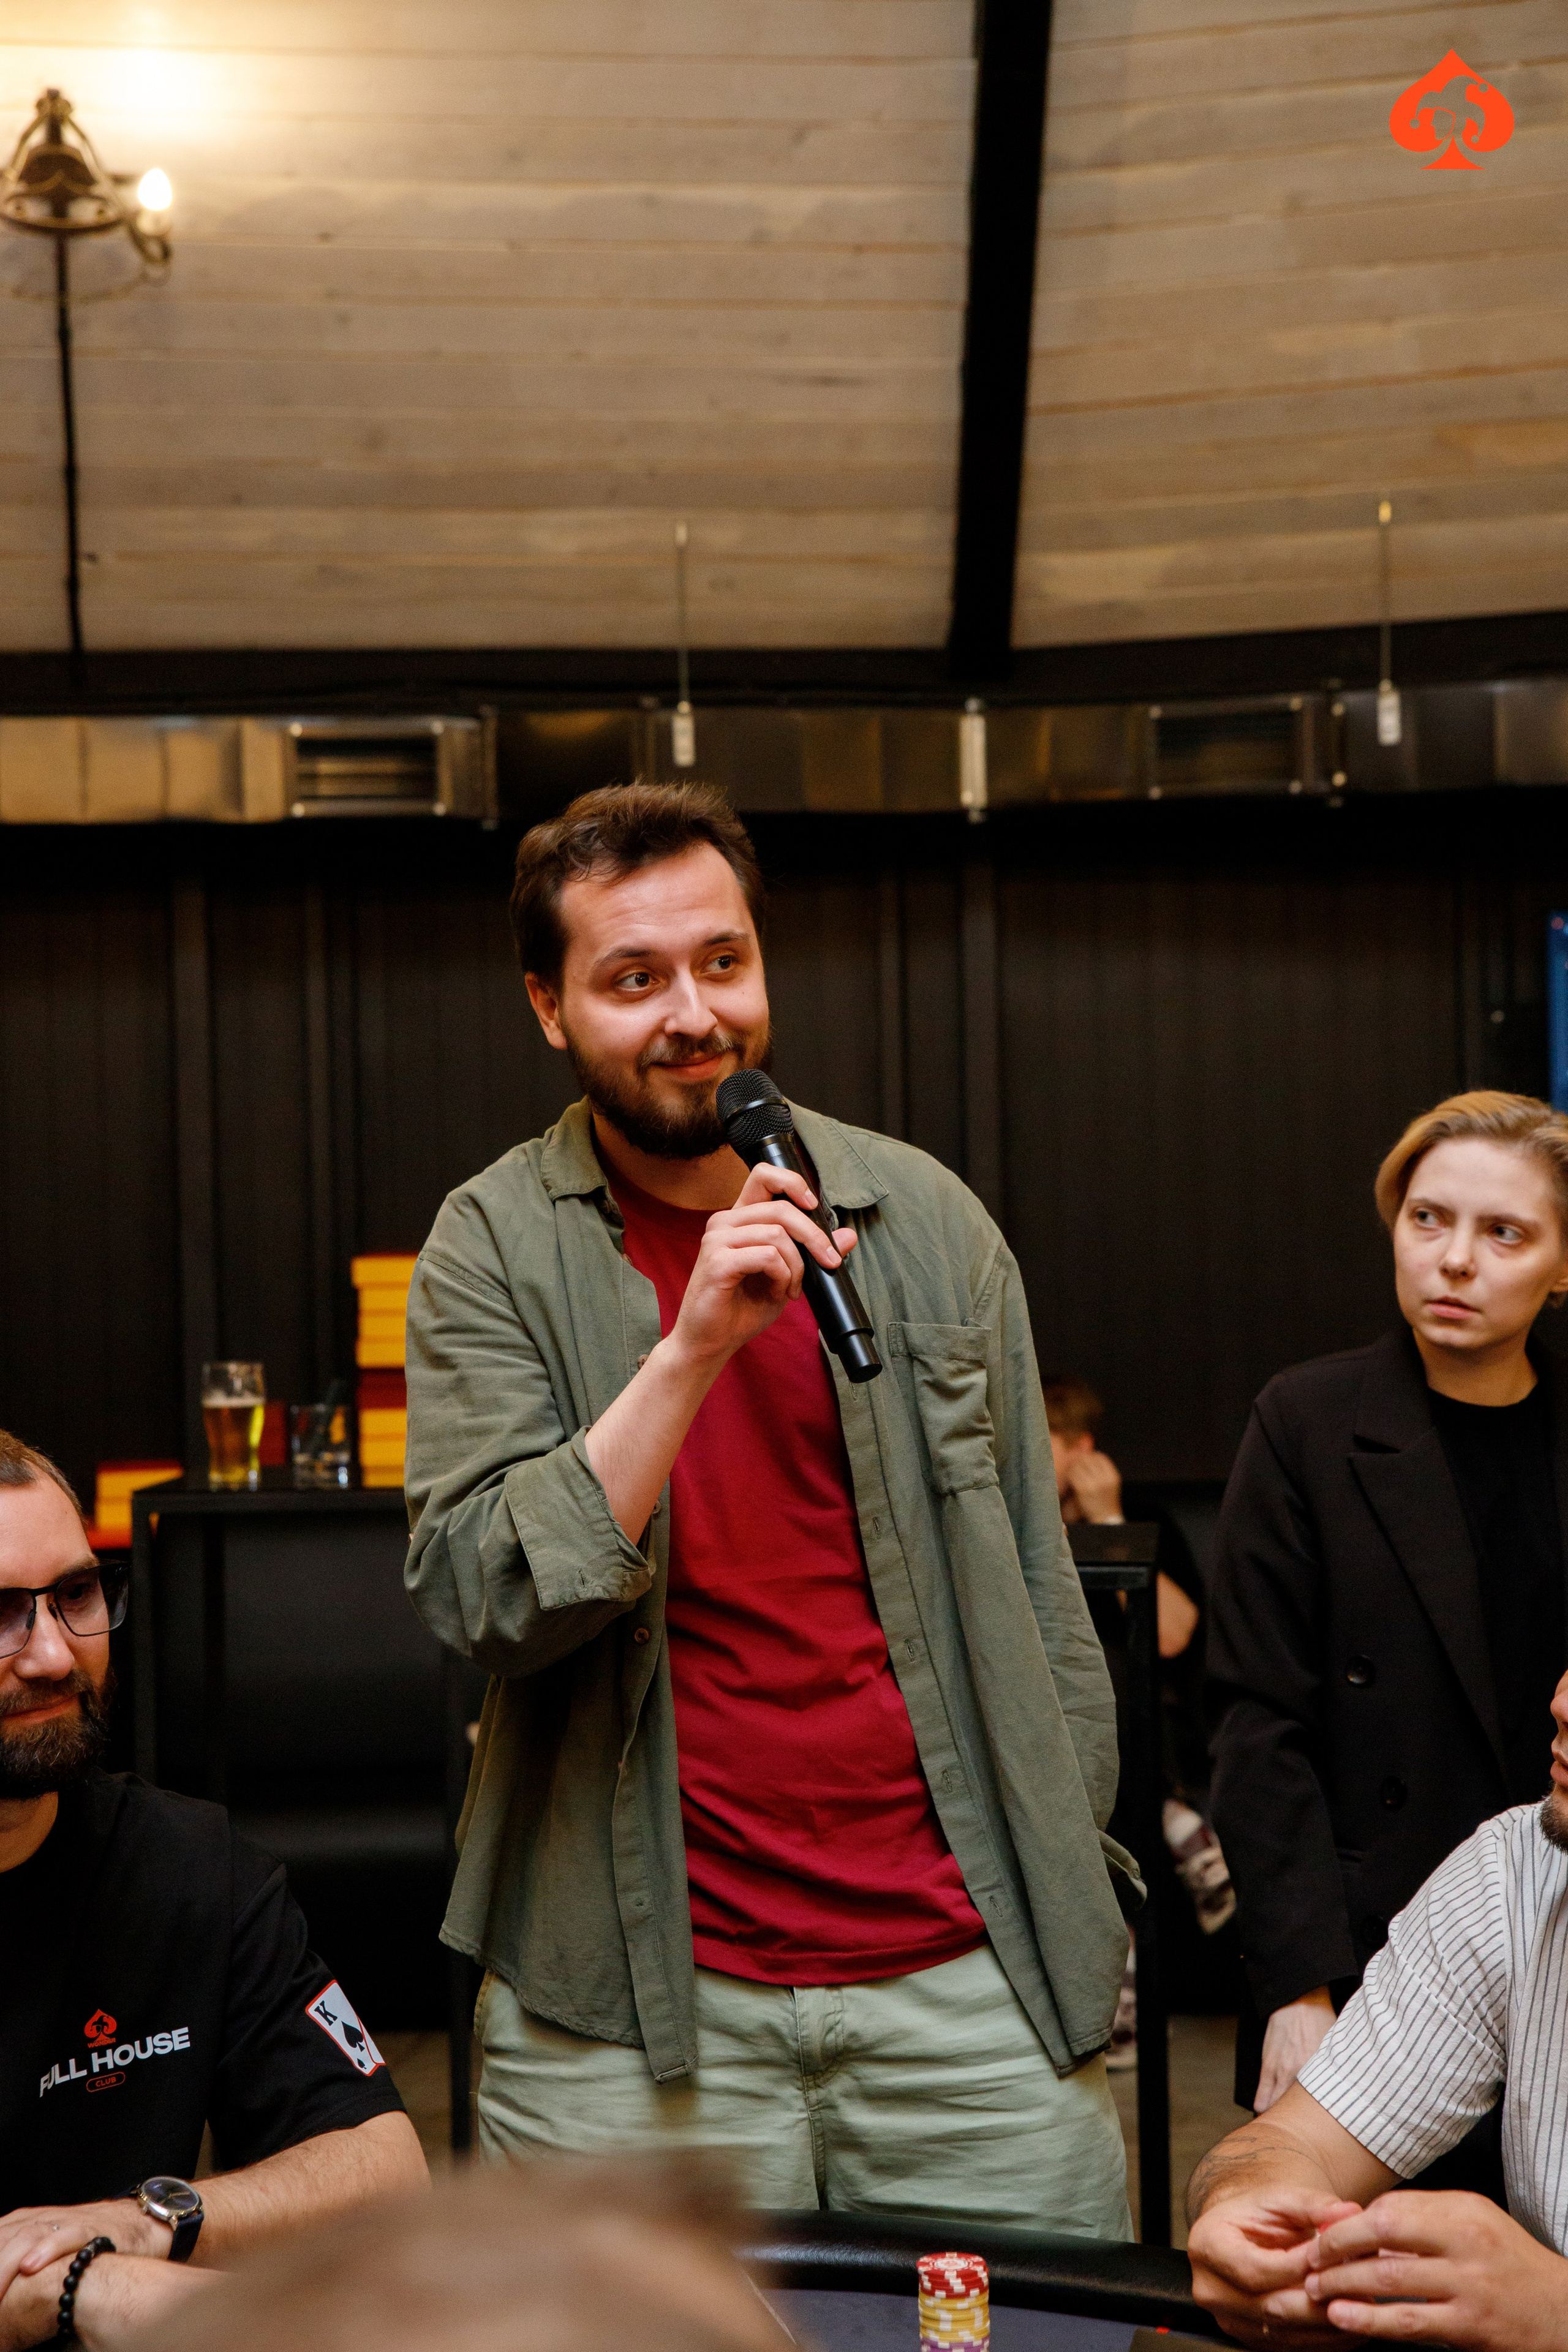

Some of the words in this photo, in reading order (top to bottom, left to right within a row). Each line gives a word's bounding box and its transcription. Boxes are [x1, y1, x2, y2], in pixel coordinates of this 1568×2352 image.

[314, 2000, 338, 2026] K
[88, 2037, 116, 2048] WONDER
[91, 2027, 190, 2073] HOUSE
[95, 2076, 116, 2087] CLUB
